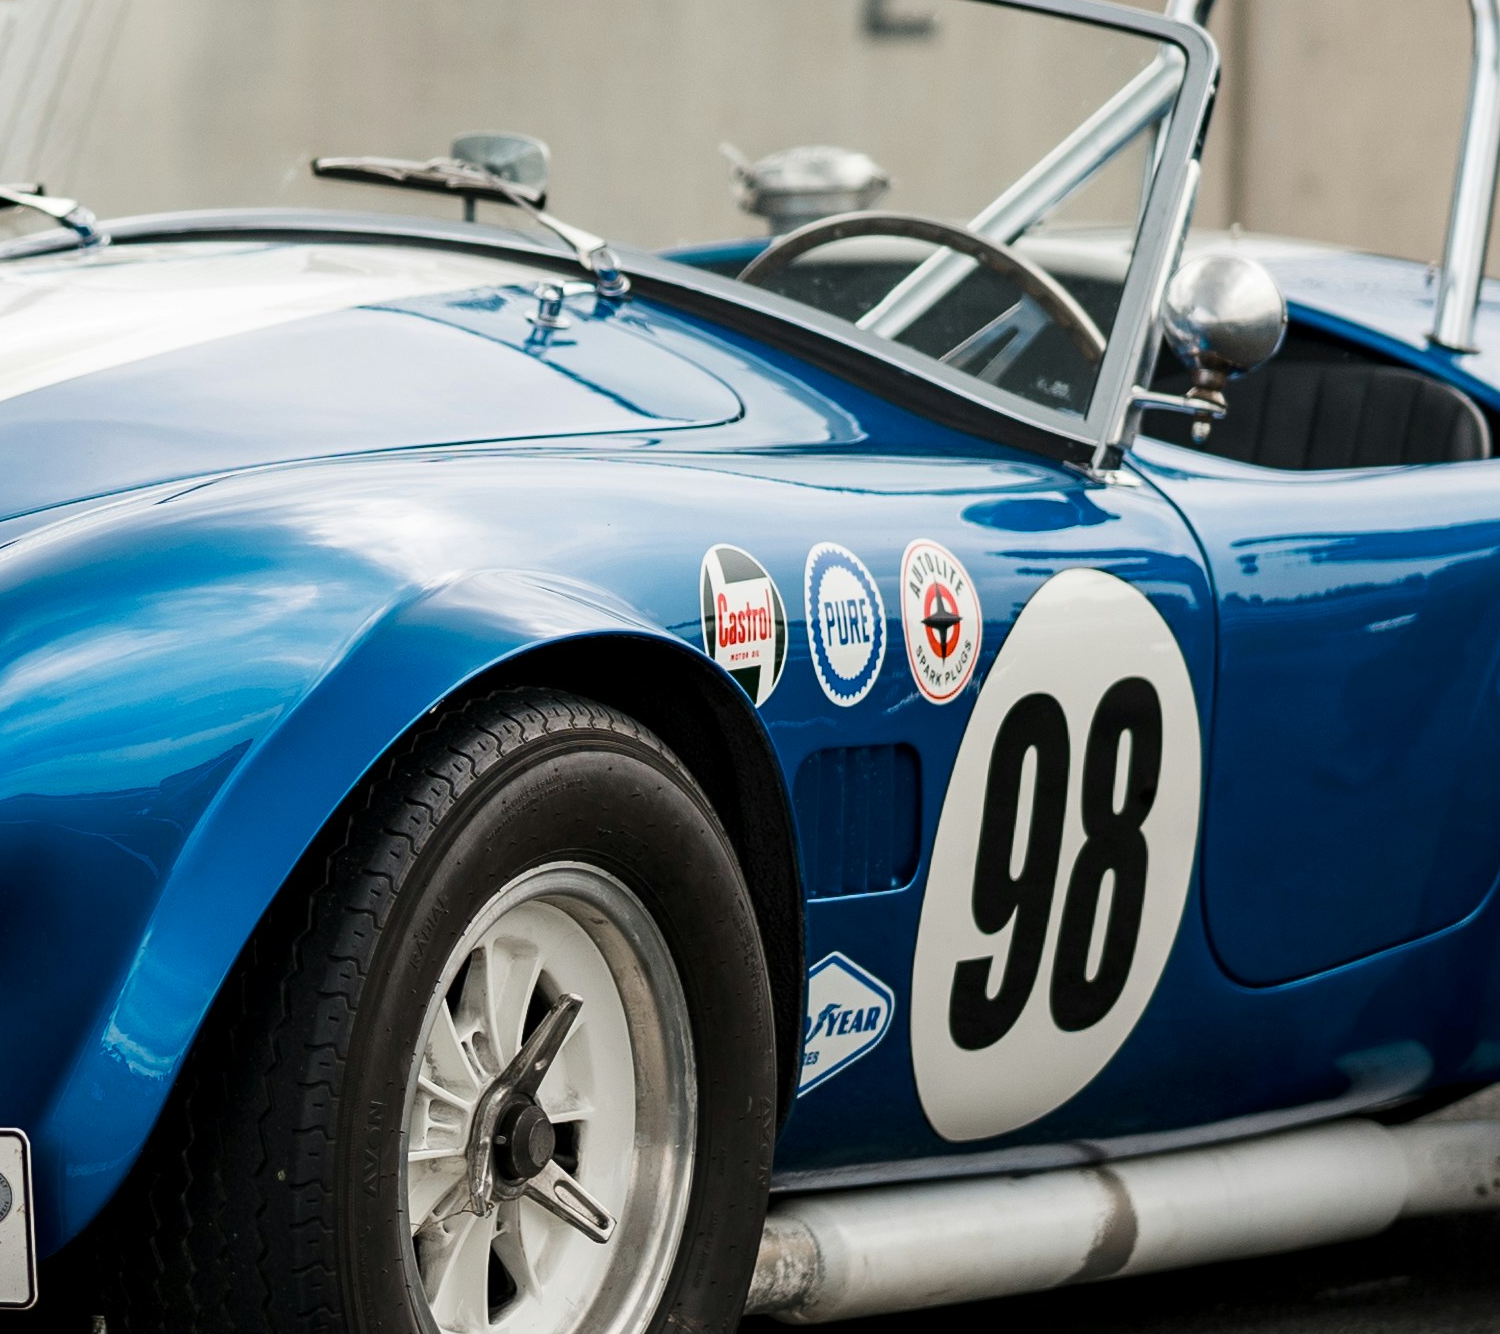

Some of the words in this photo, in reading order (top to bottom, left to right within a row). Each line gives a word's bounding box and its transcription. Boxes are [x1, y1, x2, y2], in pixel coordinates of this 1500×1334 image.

[909, 552, 965, 599] AUTOLITE
[717, 588, 772, 648] Castrol
[824, 598, 871, 647] PURE
[730, 652, 749, 662] MOTOR
[751, 650, 760, 659] OIL
[915, 645, 942, 686] SPARK
[945, 639, 972, 686] PLUGS
[948, 675, 1163, 1052] 98
